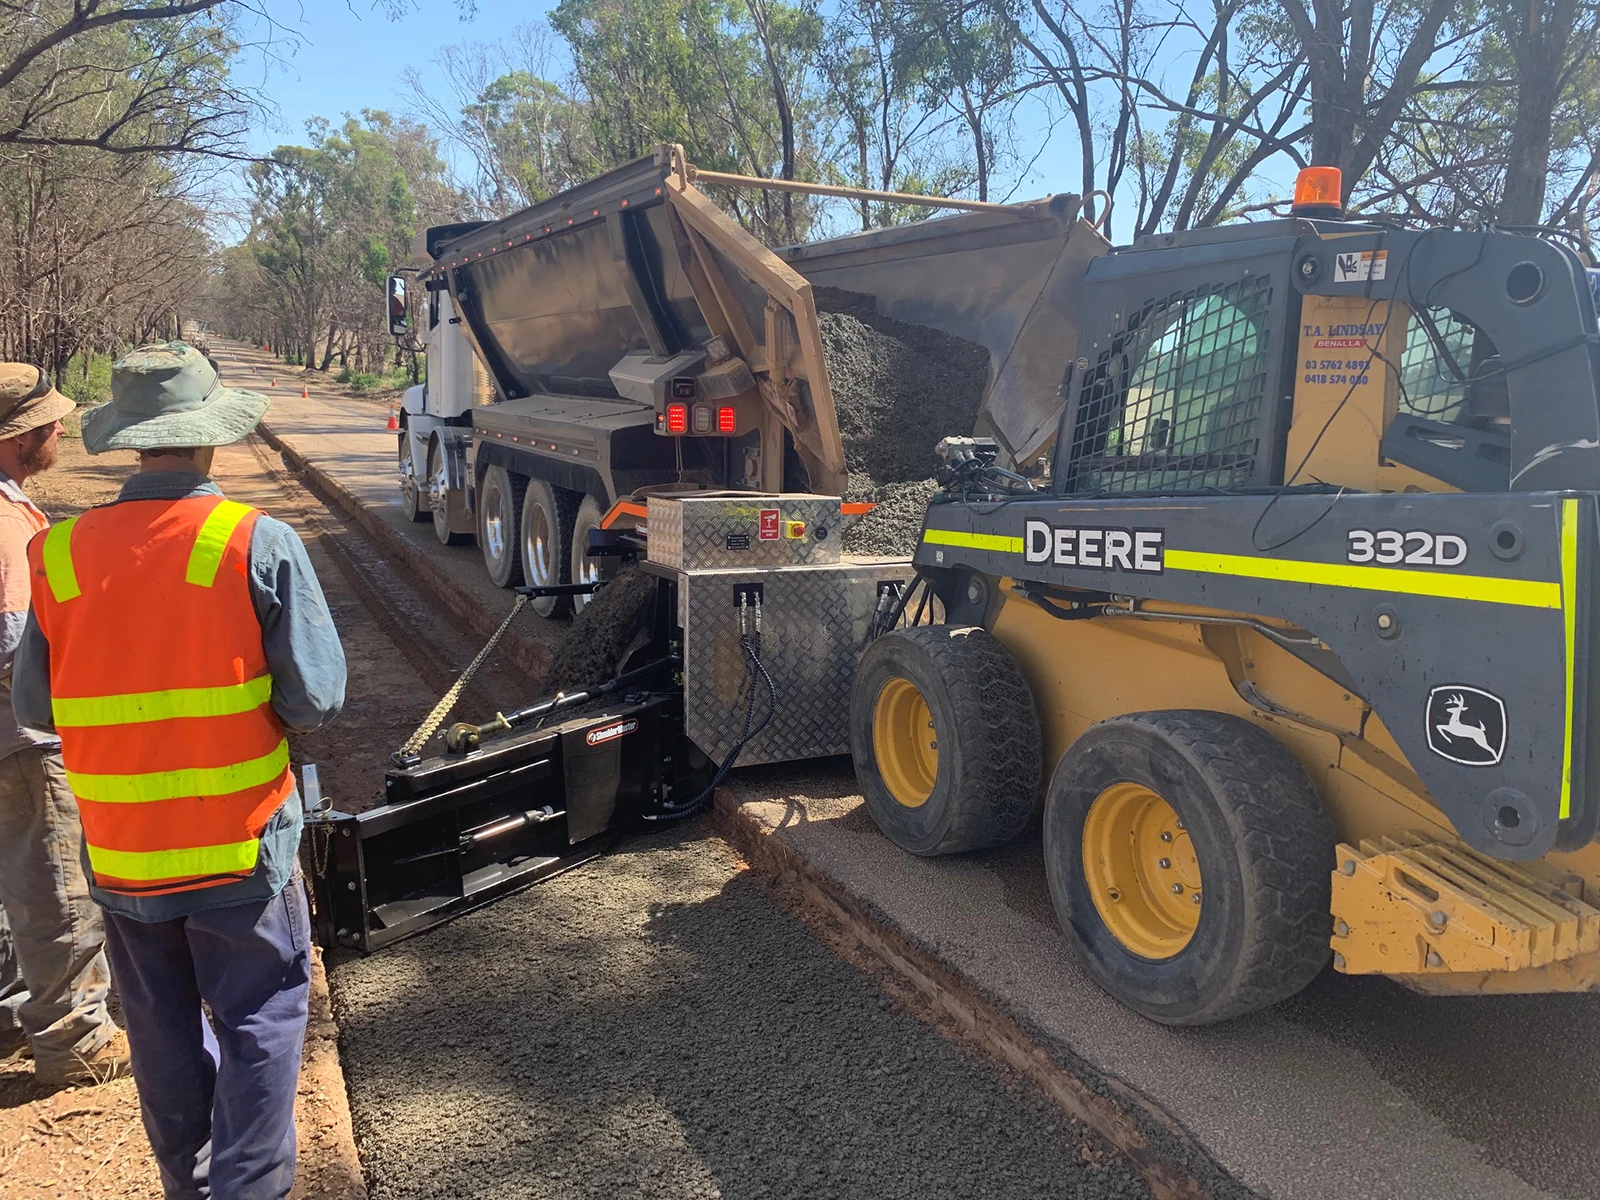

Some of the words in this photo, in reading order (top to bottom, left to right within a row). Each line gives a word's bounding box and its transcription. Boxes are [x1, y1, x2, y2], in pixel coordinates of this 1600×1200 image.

[1304, 325, 1324, 337] T.A.
[1328, 323, 1383, 337] LINDSAY
[1305, 360, 1317, 370] 03
[1319, 360, 1343, 370] 5762
[1304, 374, 1327, 384] 0418
[1329, 375, 1347, 384] 574
[1026, 520, 1162, 572] DEERE
[1347, 529, 1468, 566] 332D
